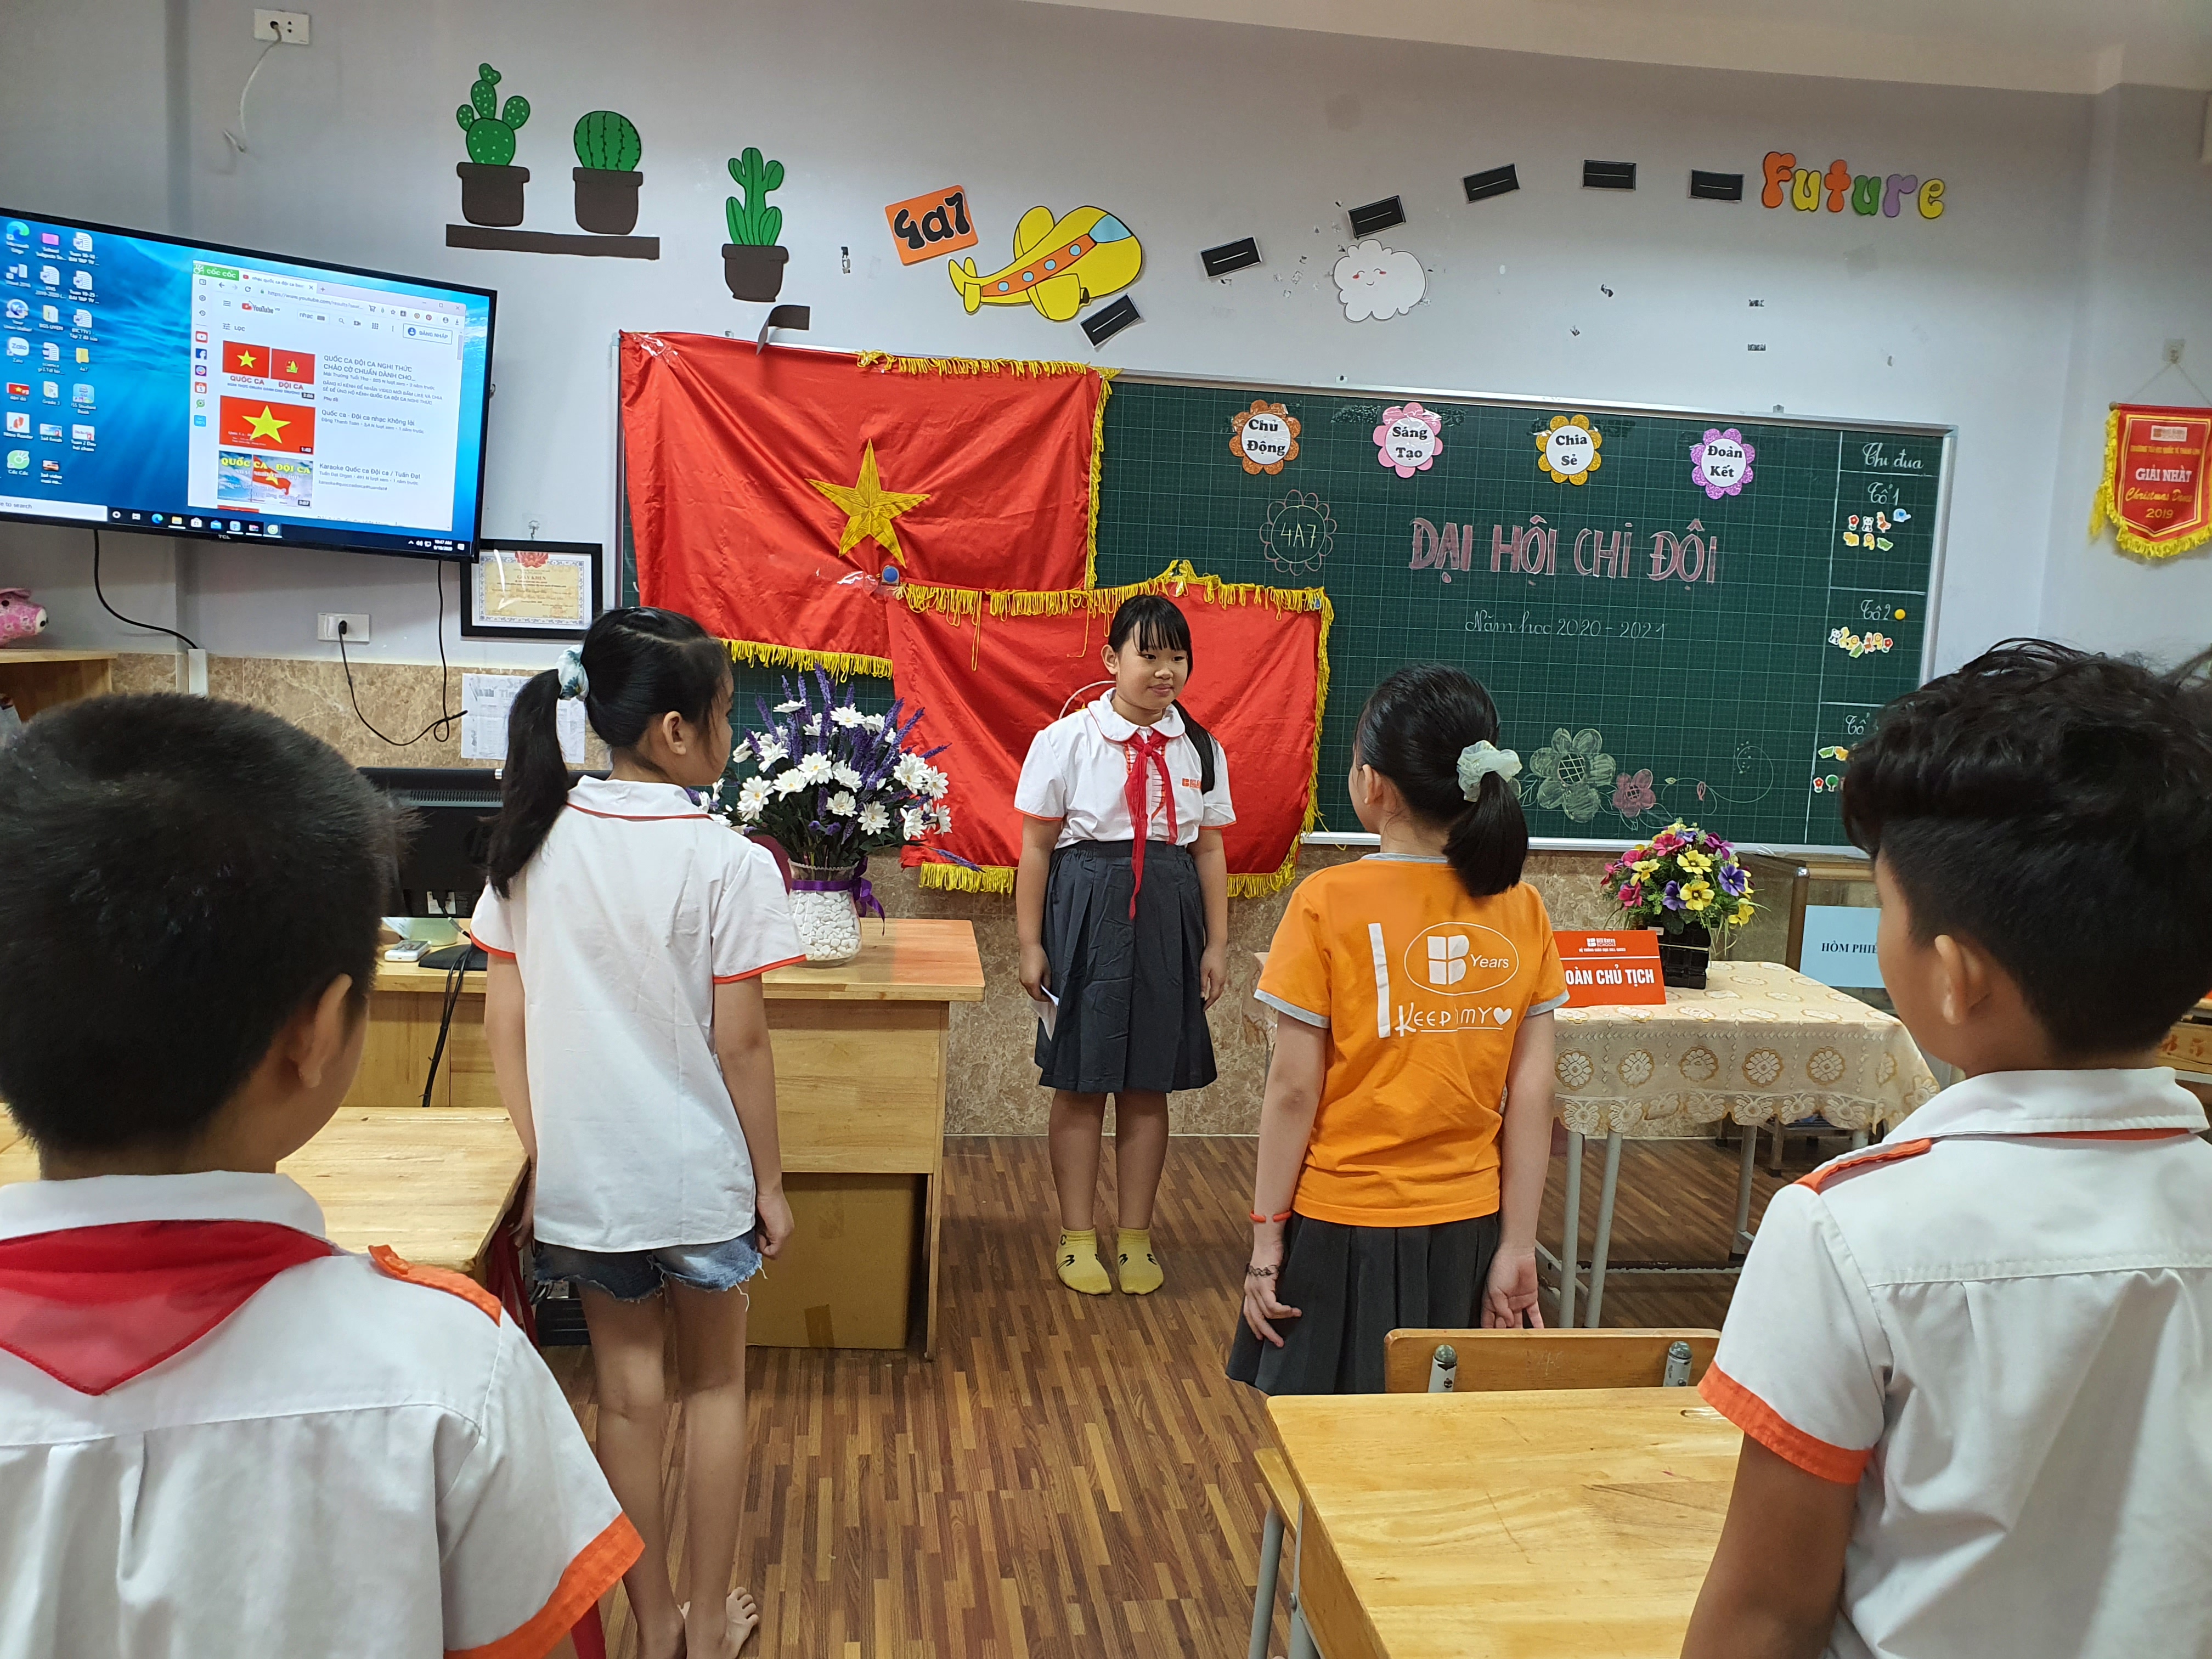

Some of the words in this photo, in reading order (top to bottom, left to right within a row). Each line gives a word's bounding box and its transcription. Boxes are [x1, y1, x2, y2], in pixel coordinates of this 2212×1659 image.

[1762, 151, 1945, 218] Future
[253, 304, 274, 314] YouTube
[324, 363, 342, 371] CHÀO
[278, 381, 292, 390] ĐỘI
[387, 417, 406, 426] Không
[1249, 419, 1278, 432] Chủ
[1392, 426, 1427, 440] Sáng
[1247, 439, 1286, 456] Động
[1555, 435, 1588, 447] Chia
[1396, 447, 1423, 460] Tạo
[1707, 445, 1743, 459] Đoàn
[1893, 449, 1924, 469] đua
[221, 456, 251, 467] QUỐC
[253, 461, 268, 470] CA
[275, 463, 294, 473] ĐỘI
[297, 466, 311, 475] CA
[319, 462, 344, 471] Karaoke
[1561, 453, 1578, 466] Sẻ
[1710, 464, 1734, 478] Kết
[2125, 487, 2169, 501] Christmas
[2145, 508, 2174, 518] 2019
[1280, 522, 1317, 549] 4A7
[1491, 515, 1557, 586] HỘI
[1646, 518, 1717, 591] ĐỘI
[1464, 610, 1513, 633] Năm
[1556, 618, 1601, 636] 2020
[1620, 621, 1664, 639] 2021
[1821, 940, 1849, 953] HÒM
[1852, 942, 1877, 954] PHIẾ
[1470, 953, 1509, 969] Years
[1565, 966, 1593, 985] OÀN
[1596, 964, 1622, 985] CHỦ
[1624, 969, 1655, 987] TỊCH
